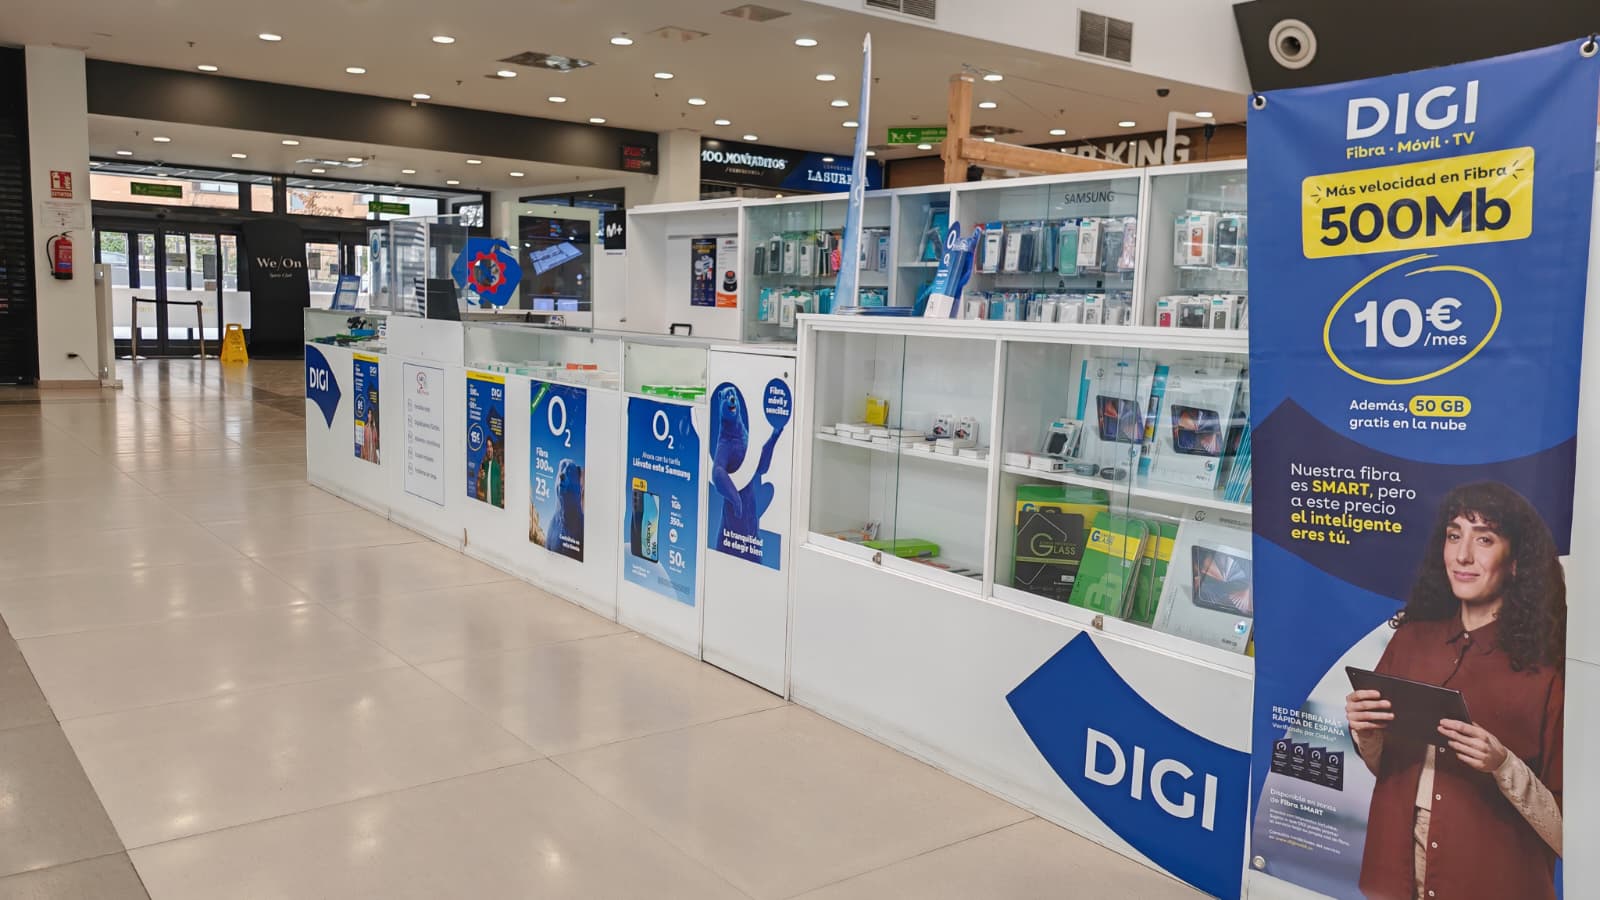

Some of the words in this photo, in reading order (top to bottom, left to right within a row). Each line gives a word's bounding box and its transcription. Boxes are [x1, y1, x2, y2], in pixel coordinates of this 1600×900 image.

[1346, 80, 1479, 140] DIGI
[1346, 145, 1386, 160] Fibra
[1397, 135, 1441, 154] Móvil
[1453, 131, 1475, 146] TV
[701, 150, 724, 163] 100
[723, 151, 787, 170] MONTADITOS
[1325, 181, 1356, 198] Más
[1359, 173, 1436, 194] velocidad
[1440, 171, 1460, 183] en
[1463, 164, 1507, 180] Fibra
[1064, 191, 1115, 205] SAMSUNG
[1320, 187, 1512, 246] 500Mb
[1354, 297, 1463, 348] 10€
[1424, 332, 1467, 347] /mes
[310, 366, 329, 392] DIGI
[1349, 399, 1409, 413] Además,
[1415, 400, 1435, 412] 50
[1440, 400, 1465, 413] GB
[1349, 417, 1390, 430] gratis
[1392, 419, 1409, 429] en
[1412, 418, 1427, 430] la
[1431, 418, 1467, 431] nube
[1291, 463, 1356, 479] Nuestra
[1360, 466, 1401, 482] fibra
[1291, 481, 1309, 492] es
[1312, 481, 1374, 498] SMART,
[1377, 486, 1416, 504] pero
[1291, 497, 1303, 507] a
[1306, 497, 1340, 510] este
[1344, 500, 1396, 519] precio
[723, 528, 730, 537] La
[1291, 511, 1307, 524] el
[1310, 512, 1403, 534] inteligente
[1030, 532, 1076, 557] GLASS
[1291, 529, 1325, 543] eres
[1329, 529, 1351, 545] tú.
[1272, 705, 1288, 715] RED
[1289, 709, 1300, 717] DE
[1301, 711, 1323, 723] FIBRA
[1272, 713, 1301, 726] RÁPIDA
[1303, 720, 1313, 729] DE
[1314, 723, 1345, 737] ESPAÑA
[1085, 727, 1218, 832] DIGI
[1280, 798, 1299, 809] Fibra
[1300, 804, 1323, 816] SMART
